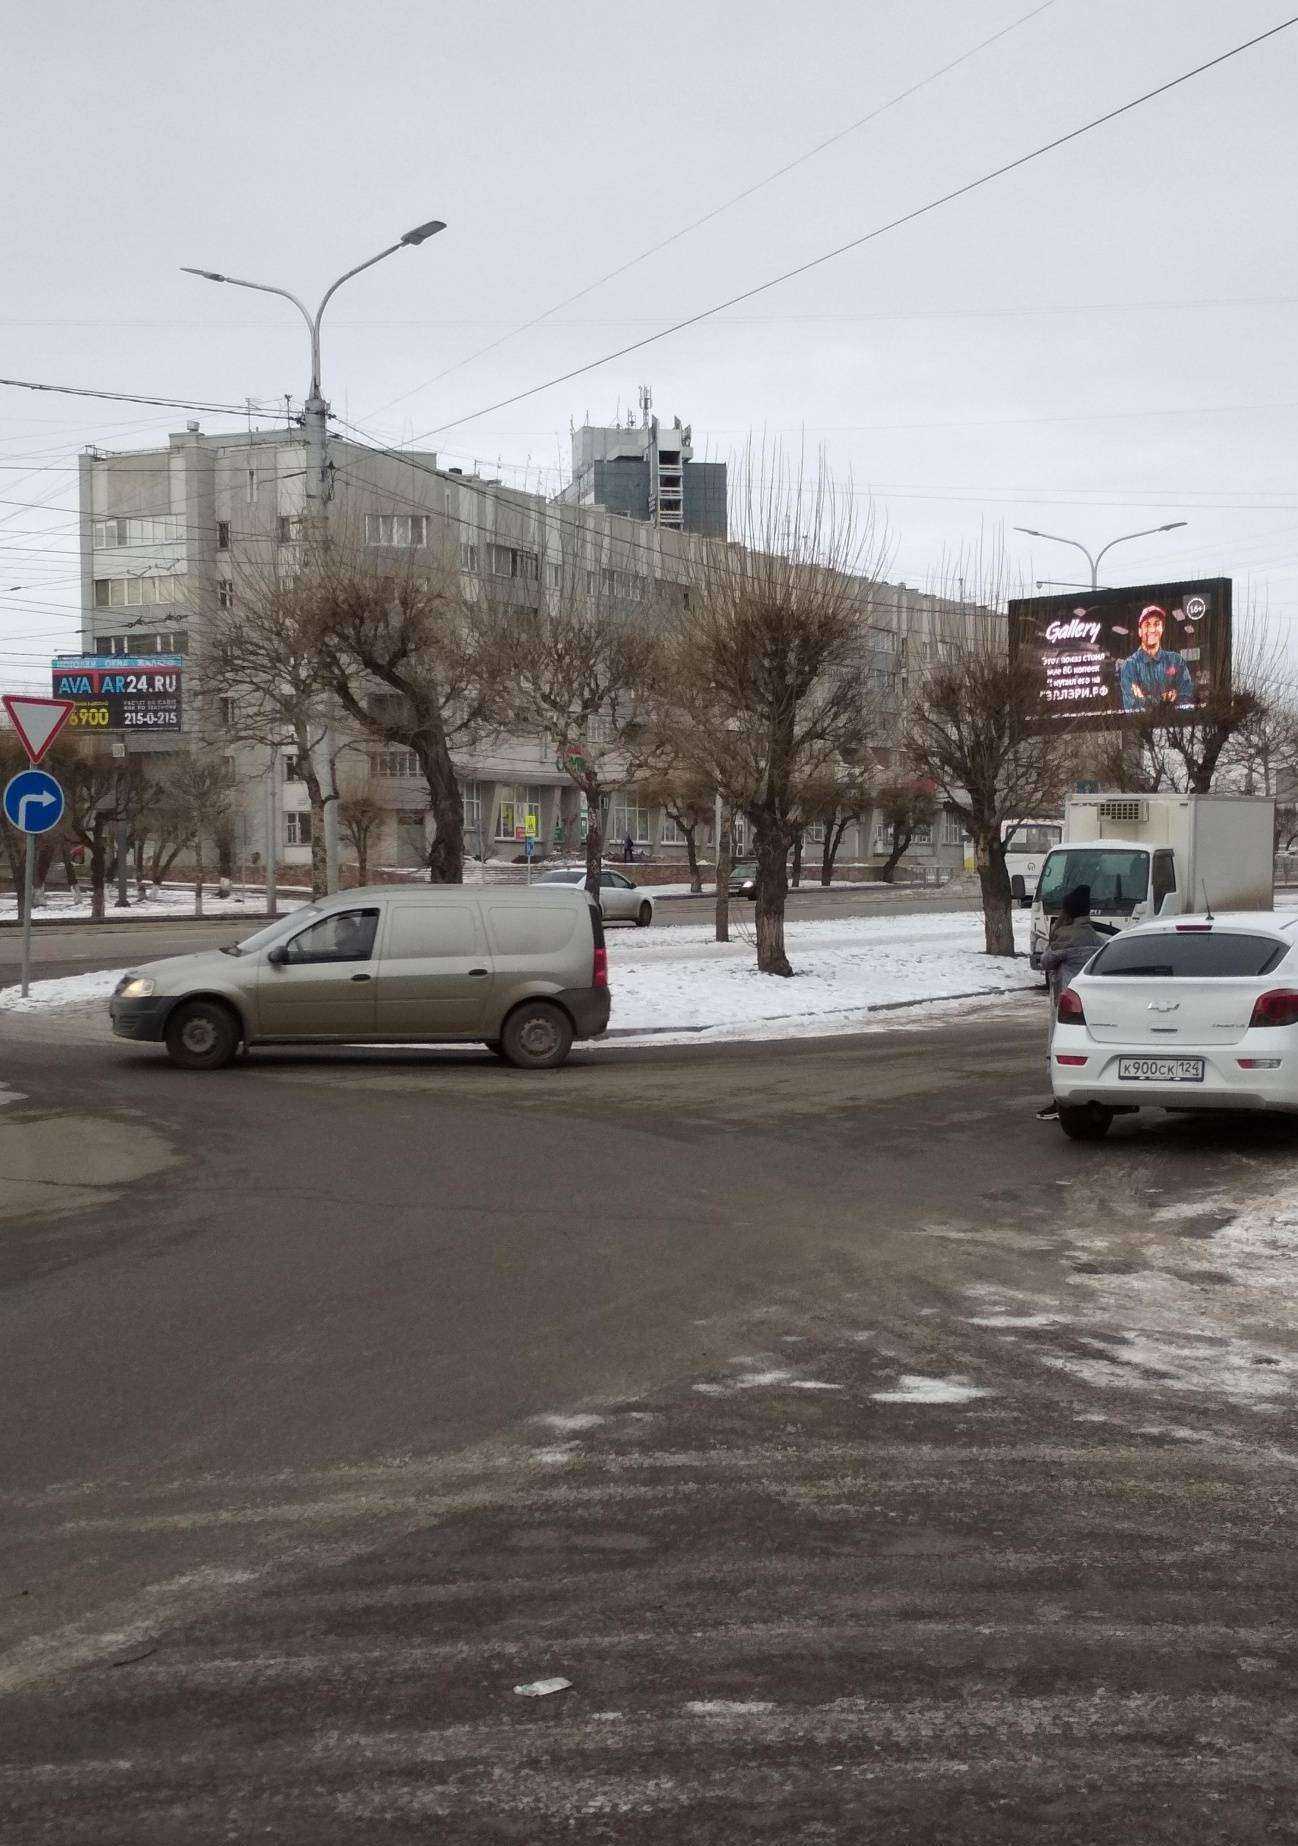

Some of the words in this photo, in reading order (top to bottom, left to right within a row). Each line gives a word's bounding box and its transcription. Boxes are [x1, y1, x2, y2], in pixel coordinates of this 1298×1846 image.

[1045, 618, 1101, 644] Gallery
[60, 674, 177, 694] AVATAR24.RU
[124, 711, 178, 725] 215-0-215
